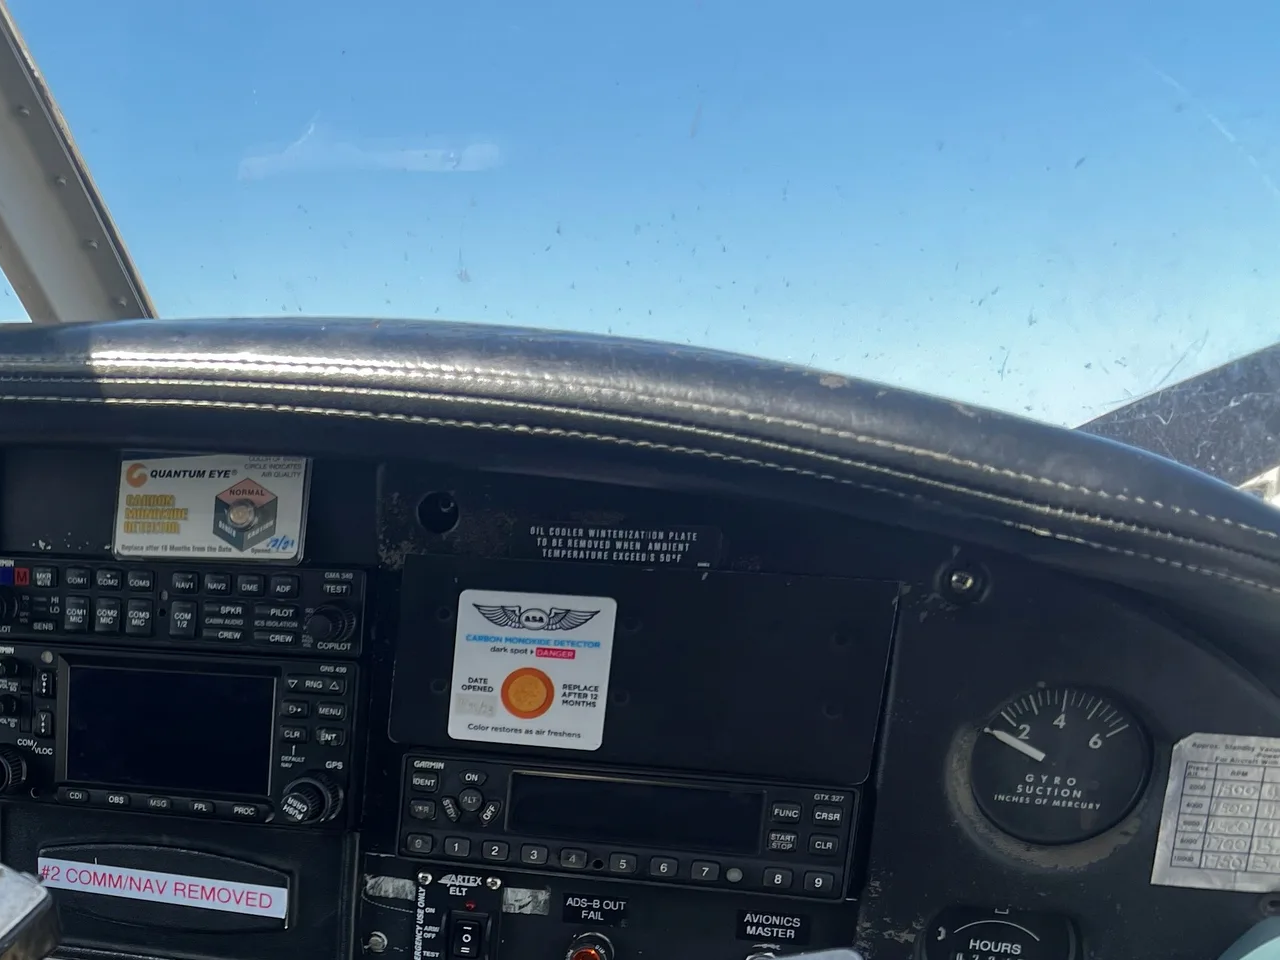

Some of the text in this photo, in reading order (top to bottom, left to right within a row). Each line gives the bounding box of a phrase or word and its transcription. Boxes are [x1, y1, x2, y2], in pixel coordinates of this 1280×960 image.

[150, 469, 207, 479] QUANTUM
[530, 526, 544, 535] OIL
[549, 527, 584, 537] COOLER
[669, 531, 698, 541] PLATE
[537, 537, 690, 552] TO BE REMOVED WHEN AMBIENT
[542, 548, 608, 560] TEMPERATURE
[98, 578, 118, 586] COM2
[326, 585, 347, 593] TEST
[317, 642, 352, 650] COPILOT
[466, 634, 601, 648] CARBON MONOXIDE DETECTOR
[468, 677, 488, 685] DATE
[461, 684, 493, 692] OPENED
[563, 684, 599, 692] REPLACE
[562, 700, 596, 708] MONTHS
[1052, 714, 1066, 729] 4
[492, 726, 522, 734] restores
[548, 730, 581, 739] freshens
[1088, 734, 1102, 749] 6
[1025, 774, 1076, 786] GYRO
[1016, 784, 1082, 798] SUCTION
[108, 796, 124, 804] OBS
[994, 794, 1030, 804] INCHES
[1052, 800, 1100, 810] MERCURY
[234, 806, 256, 816] PROC
[774, 809, 798, 819] FUNC
[815, 811, 840, 821] CRSR
[815, 841, 832, 850] CLR
[450, 874, 482, 887] ARTEX
[774, 874, 782, 885] 8
[815, 877, 823, 888] 9
[42, 865, 273, 909] #2 COMM/NAV REMOVED
[449, 887, 468, 896] ELT
[418, 887, 426, 905] ONLY
[603, 900, 626, 911] OUT
[417, 906, 425, 924] USE
[581, 911, 604, 920] FAIL
[744, 913, 801, 927] AVIONICS
[746, 925, 795, 939] MASTER
[969, 939, 1021, 955] HOURS
